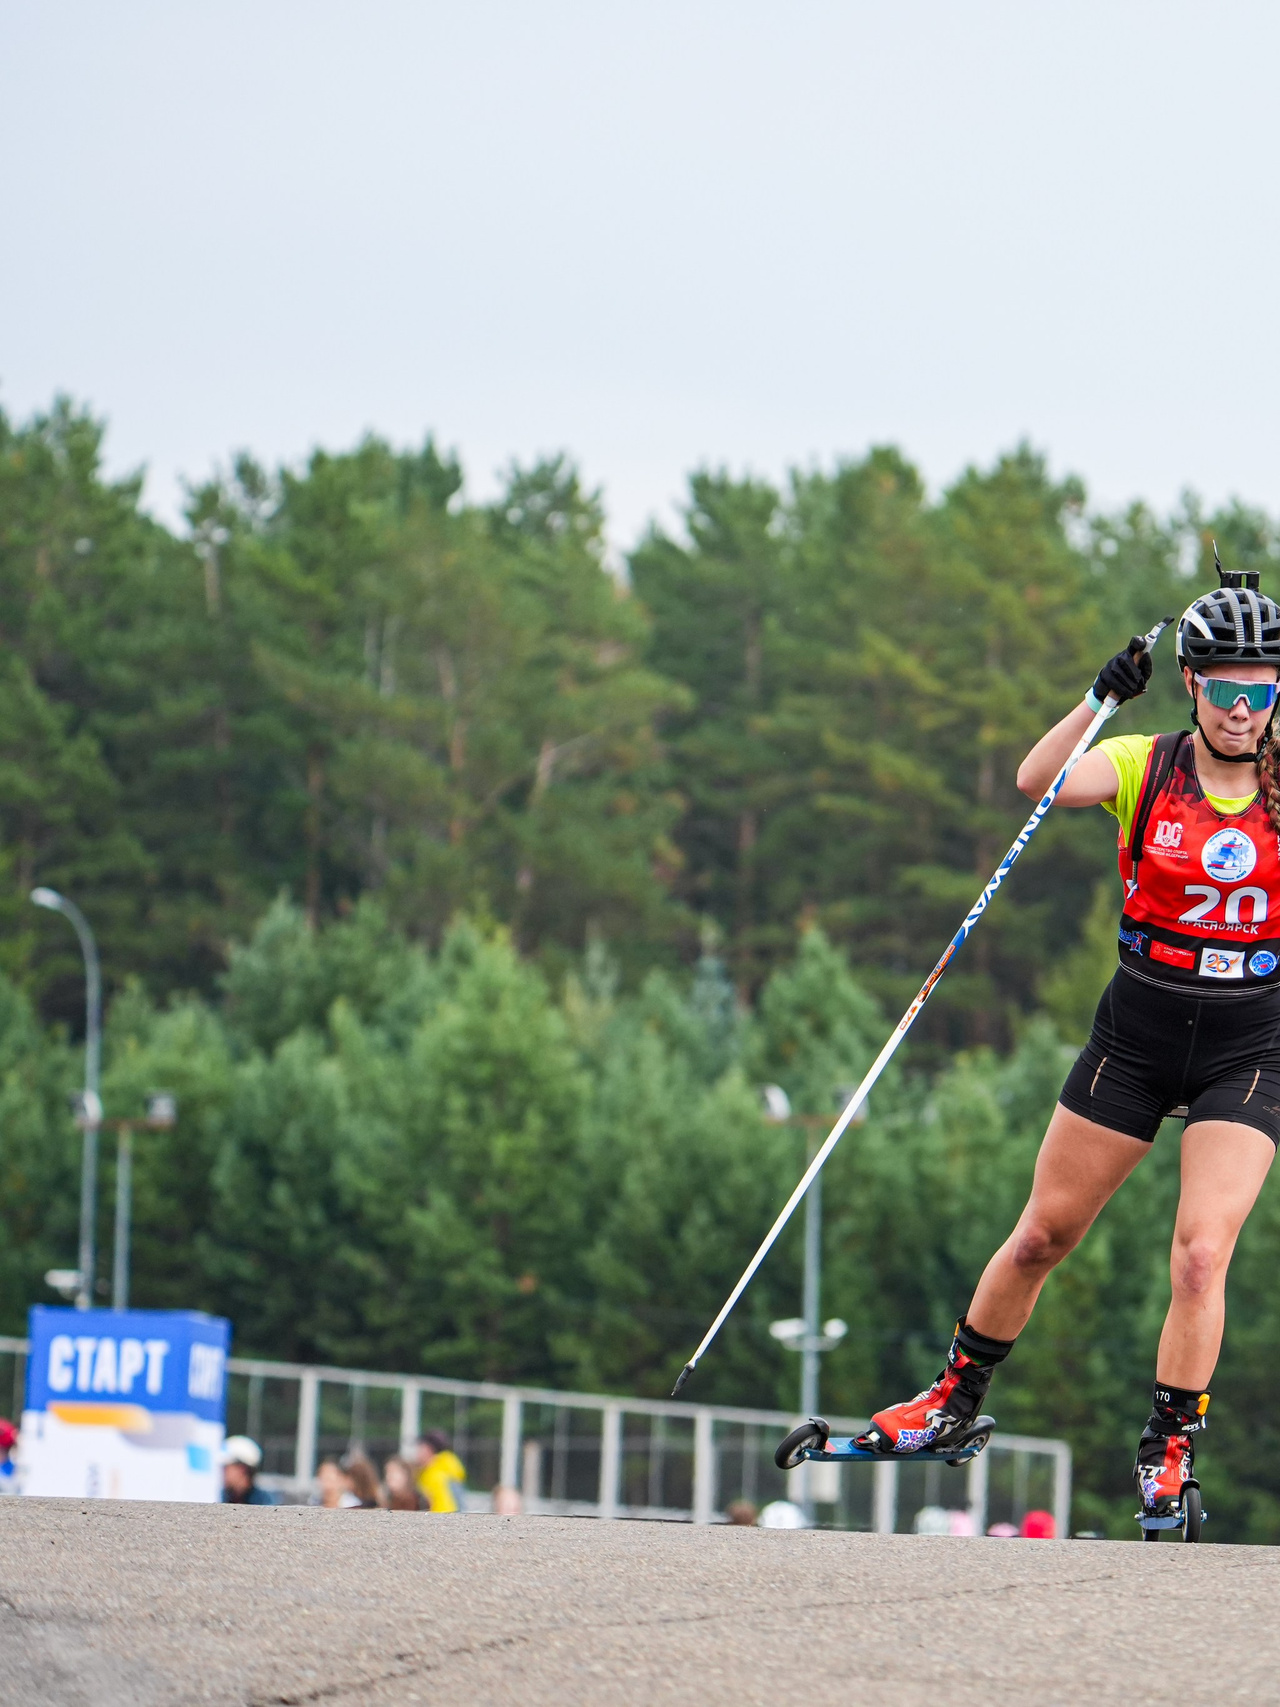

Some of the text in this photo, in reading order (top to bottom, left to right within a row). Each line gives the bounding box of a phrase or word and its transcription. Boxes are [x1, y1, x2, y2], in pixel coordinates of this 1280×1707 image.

[1178, 884, 1269, 924] 20
[1177, 919, 1259, 935] АСНОЯРСК
[48, 1334, 169, 1396] СТАРТ
[1156, 1390, 1170, 1402] 170
